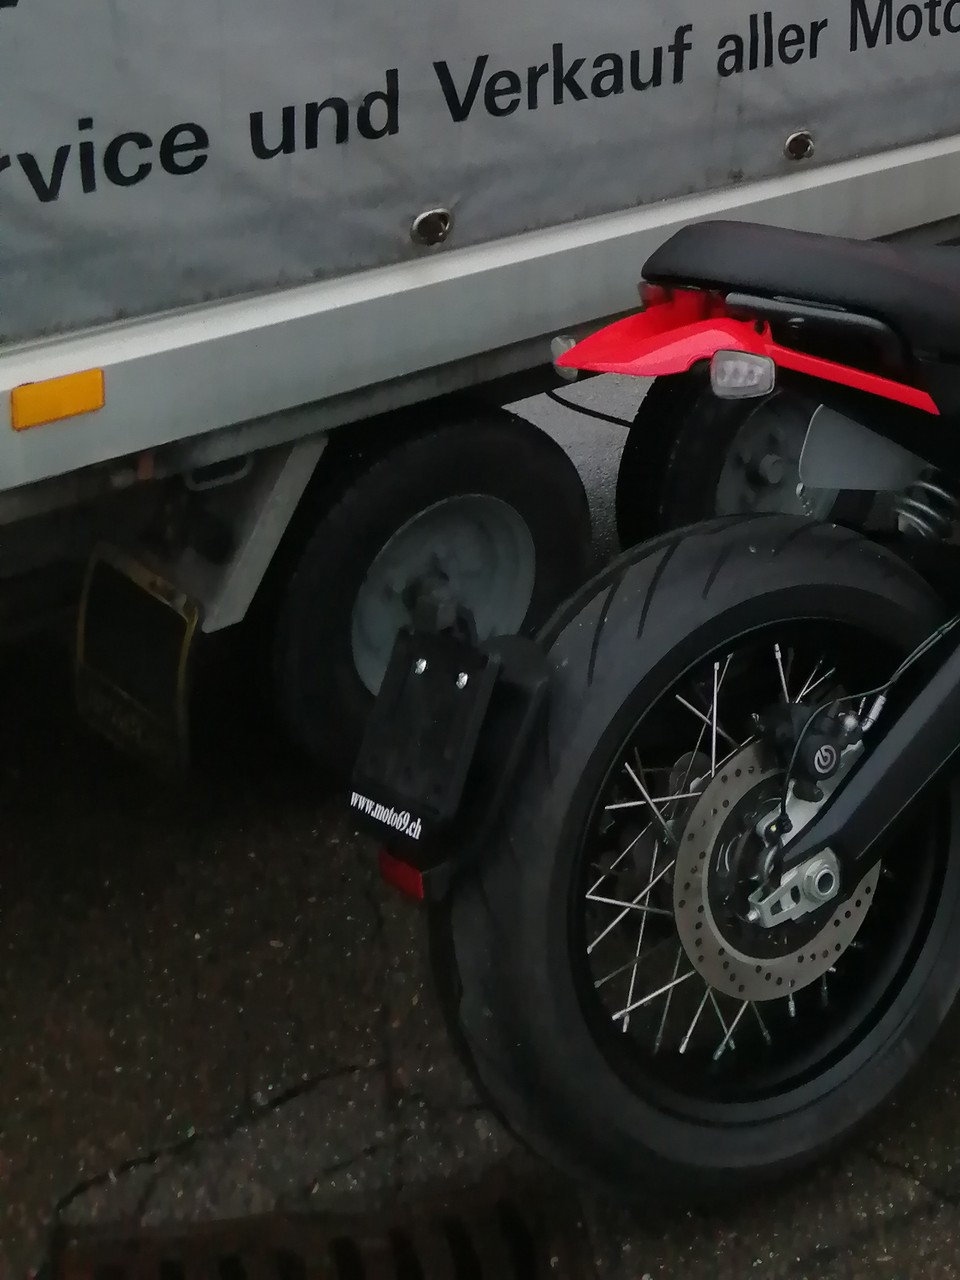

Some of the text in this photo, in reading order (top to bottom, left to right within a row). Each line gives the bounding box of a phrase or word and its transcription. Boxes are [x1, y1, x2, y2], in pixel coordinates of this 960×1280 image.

[0, 117, 209, 203] vice
[250, 69, 399, 160] und
[433, 25, 692, 123] Verkauf
[717, 11, 828, 78] aller
[350, 791, 422, 840] www.moto69.ch
